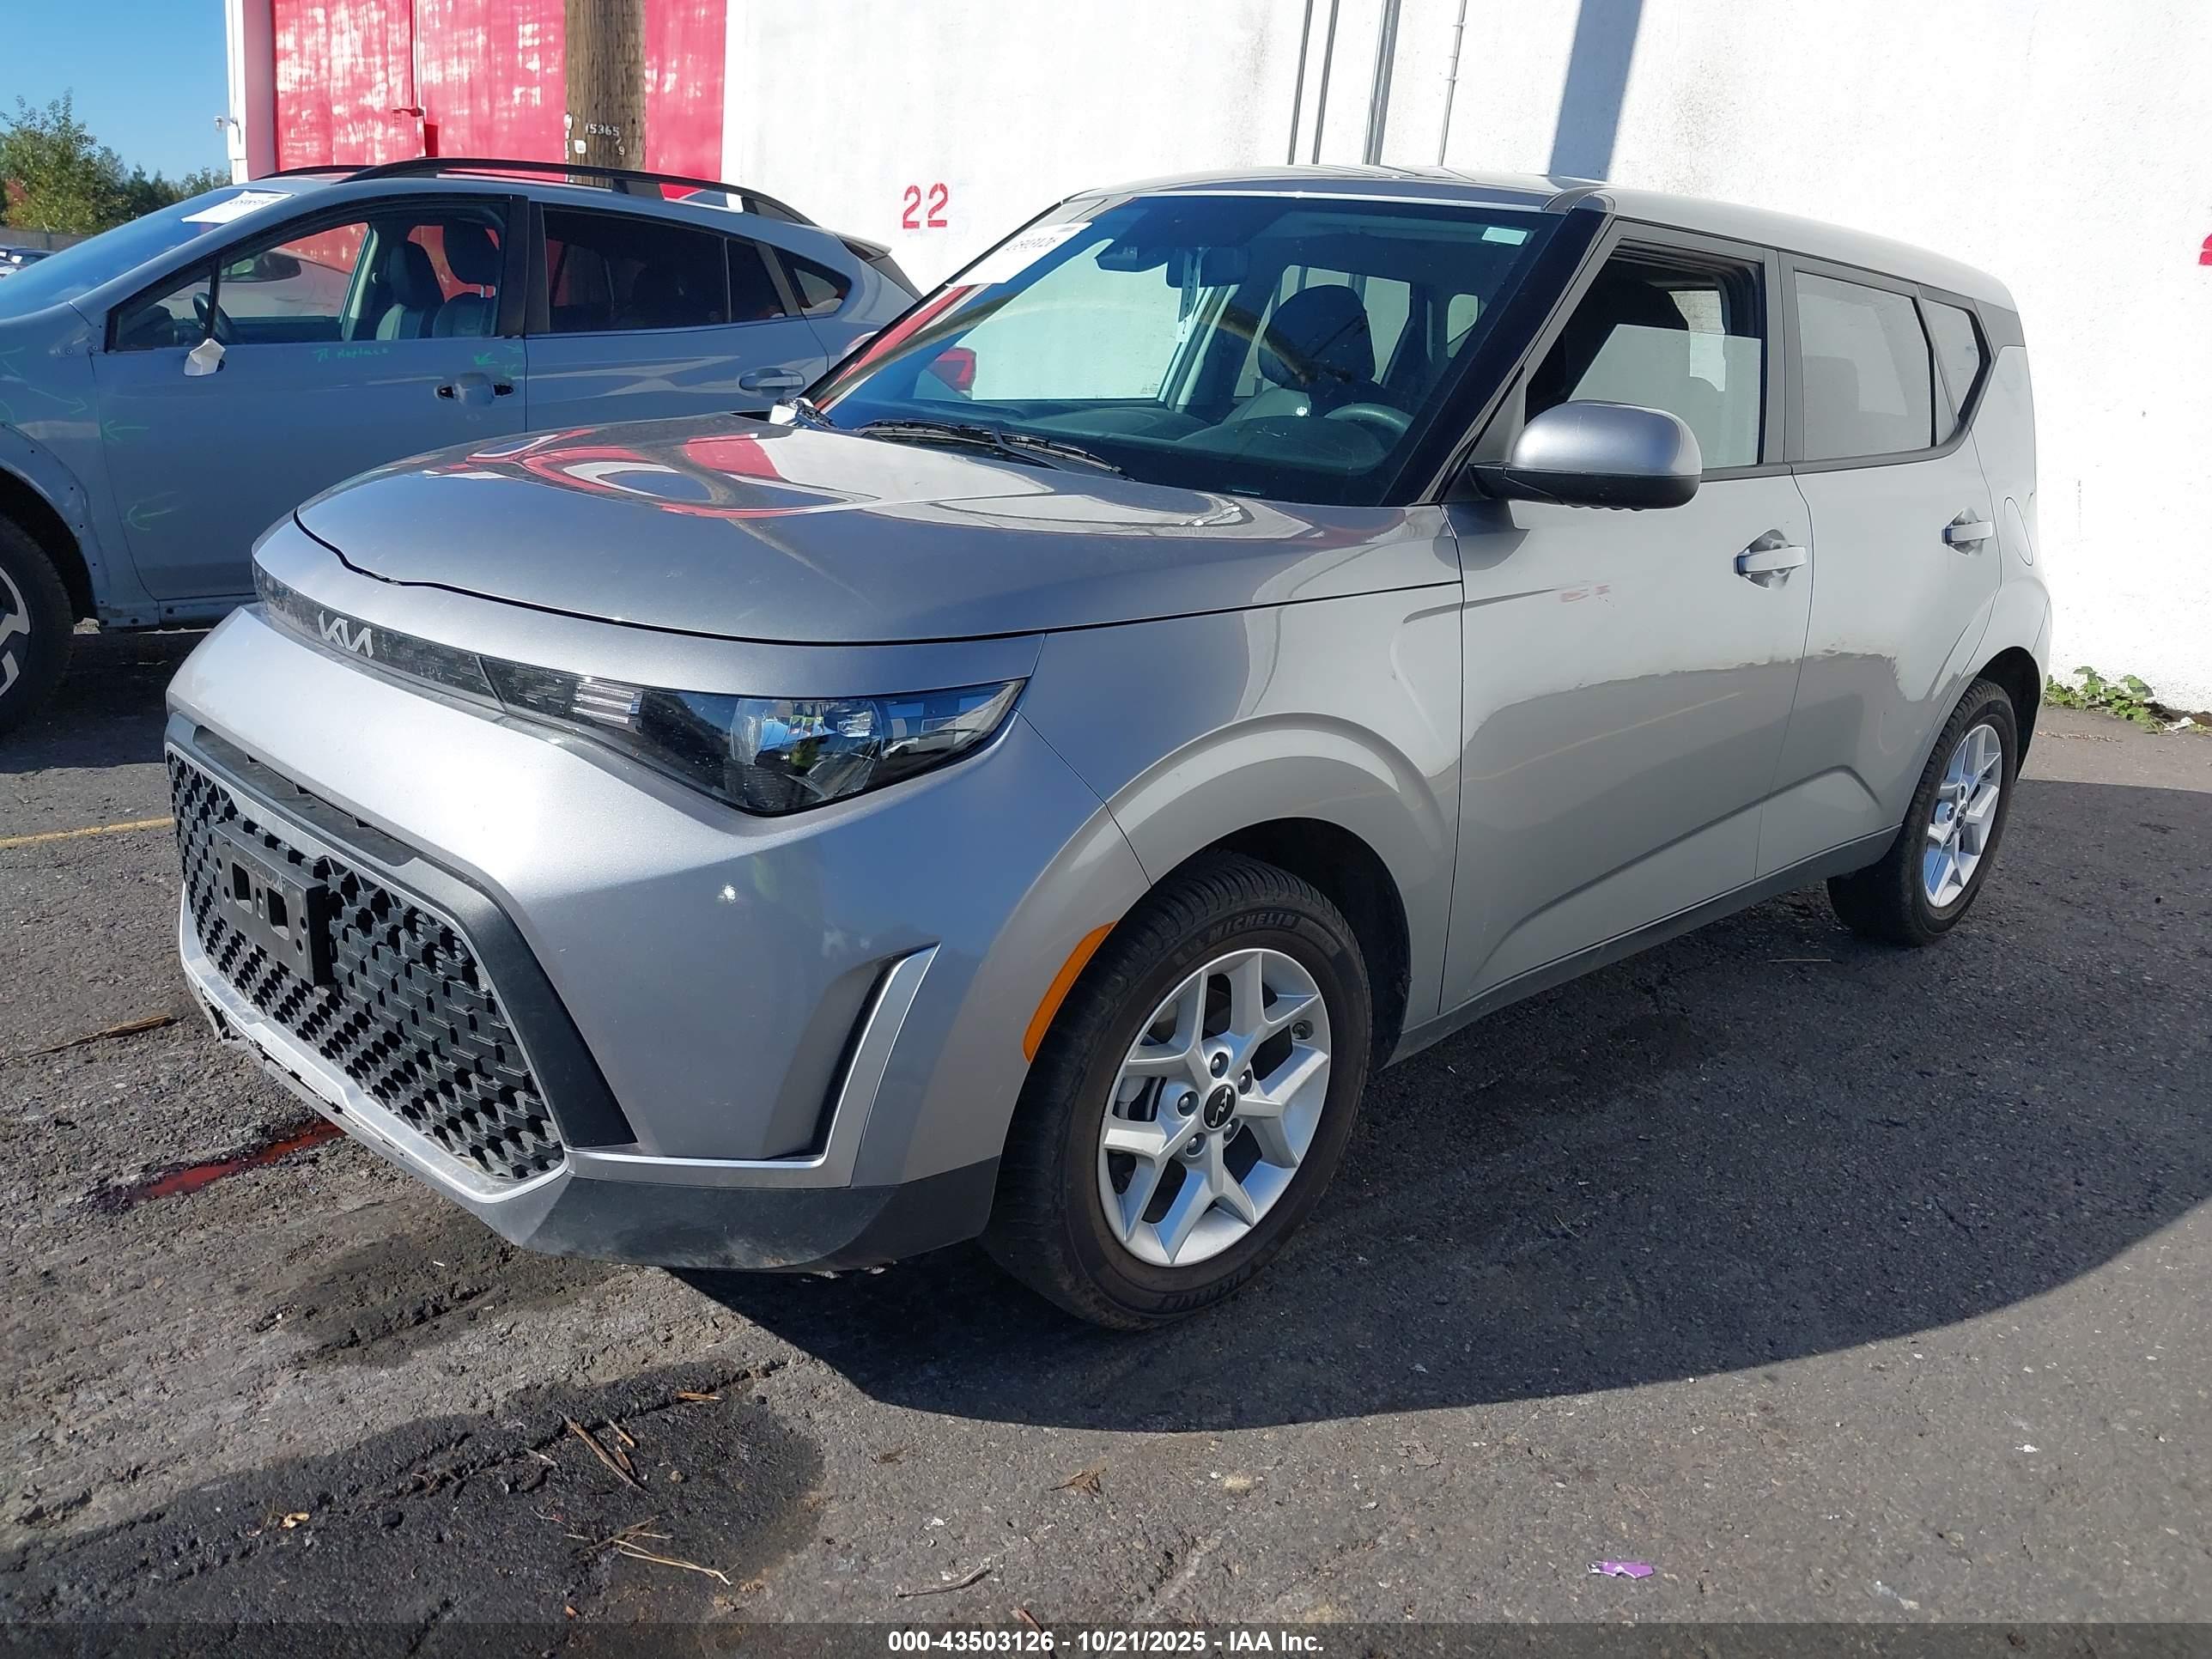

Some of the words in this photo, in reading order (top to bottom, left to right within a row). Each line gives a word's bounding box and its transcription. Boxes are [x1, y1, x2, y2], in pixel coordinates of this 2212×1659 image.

[902, 183, 948, 229] 22
[318, 610, 374, 659] KIA
[1208, 912, 1297, 942] MICHELIN
